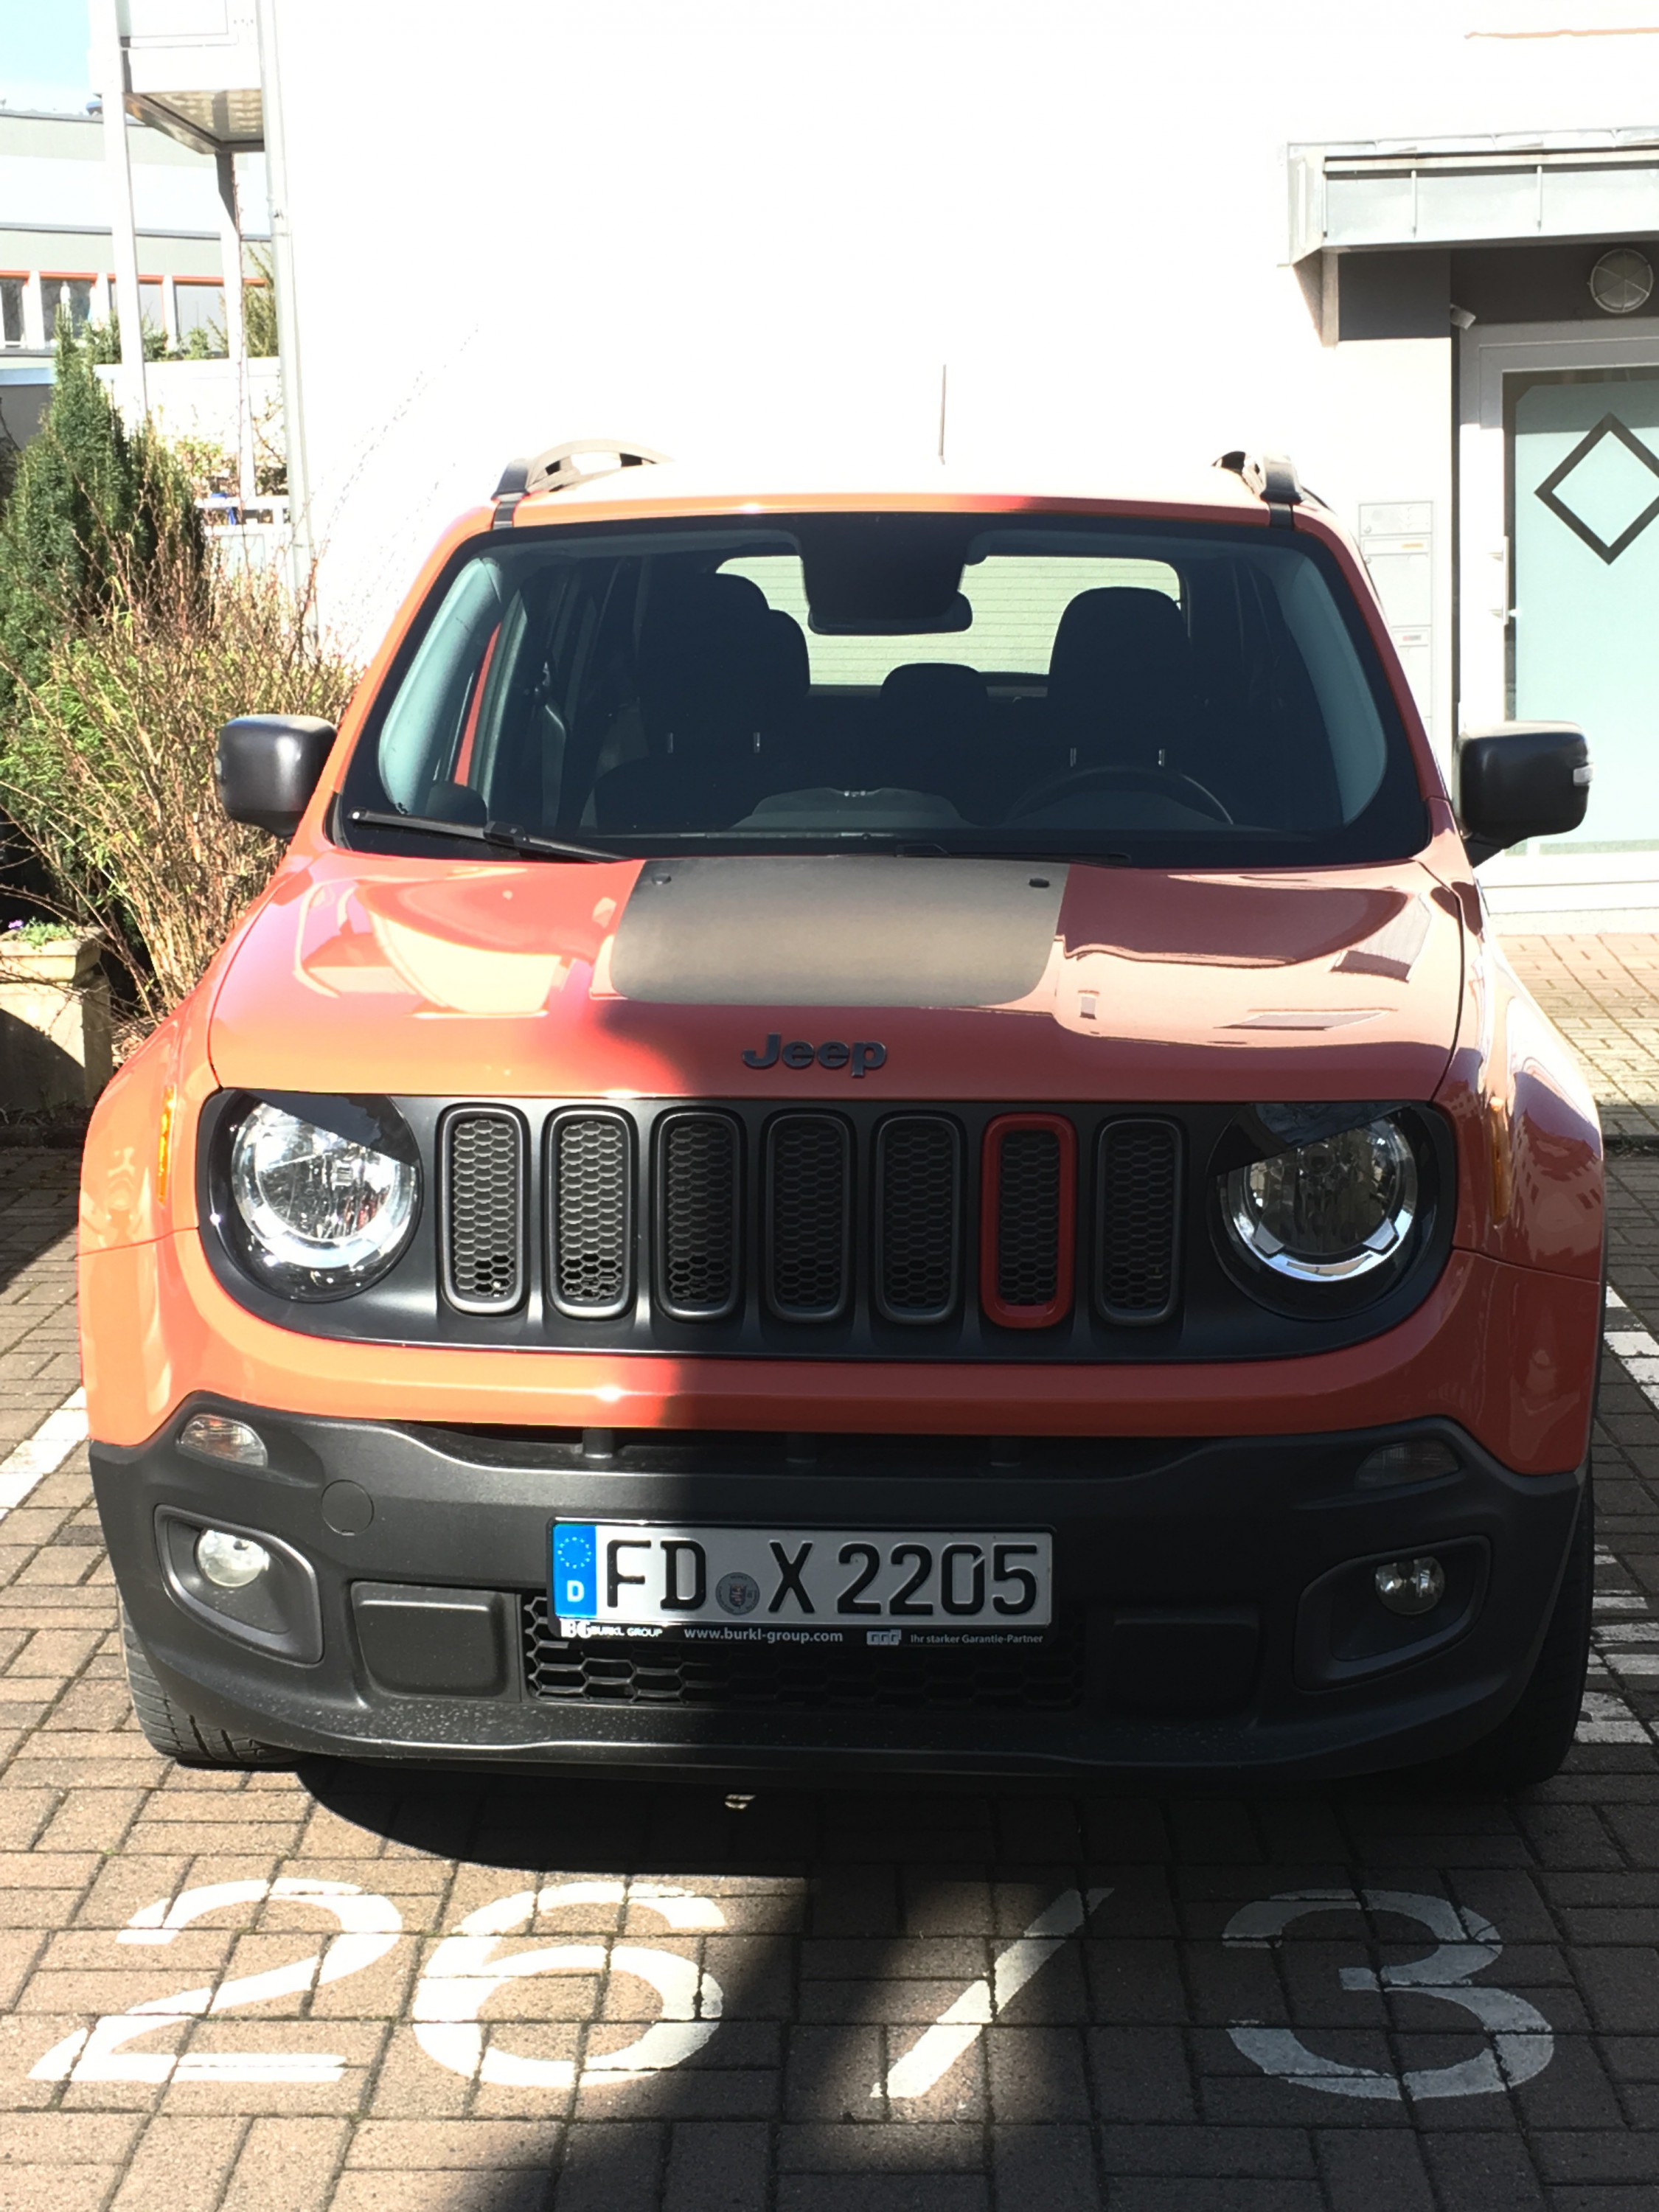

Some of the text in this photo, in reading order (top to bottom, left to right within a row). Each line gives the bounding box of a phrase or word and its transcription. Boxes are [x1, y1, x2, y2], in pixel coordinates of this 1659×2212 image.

[742, 1032, 887, 1078] Jeep
[607, 1540, 706, 1610] FD
[768, 1540, 815, 1614] X
[837, 1543, 1037, 1615] 2205
[567, 1580, 584, 1601] D
[627, 1627, 663, 1637] GROUP
[684, 1627, 844, 1644] www.burkl-group.com
[910, 1634, 1044, 1644] Ihr starker Garantie-Partner
[27, 1877, 726, 2088] 26
[1222, 1888, 1554, 2101] 3
